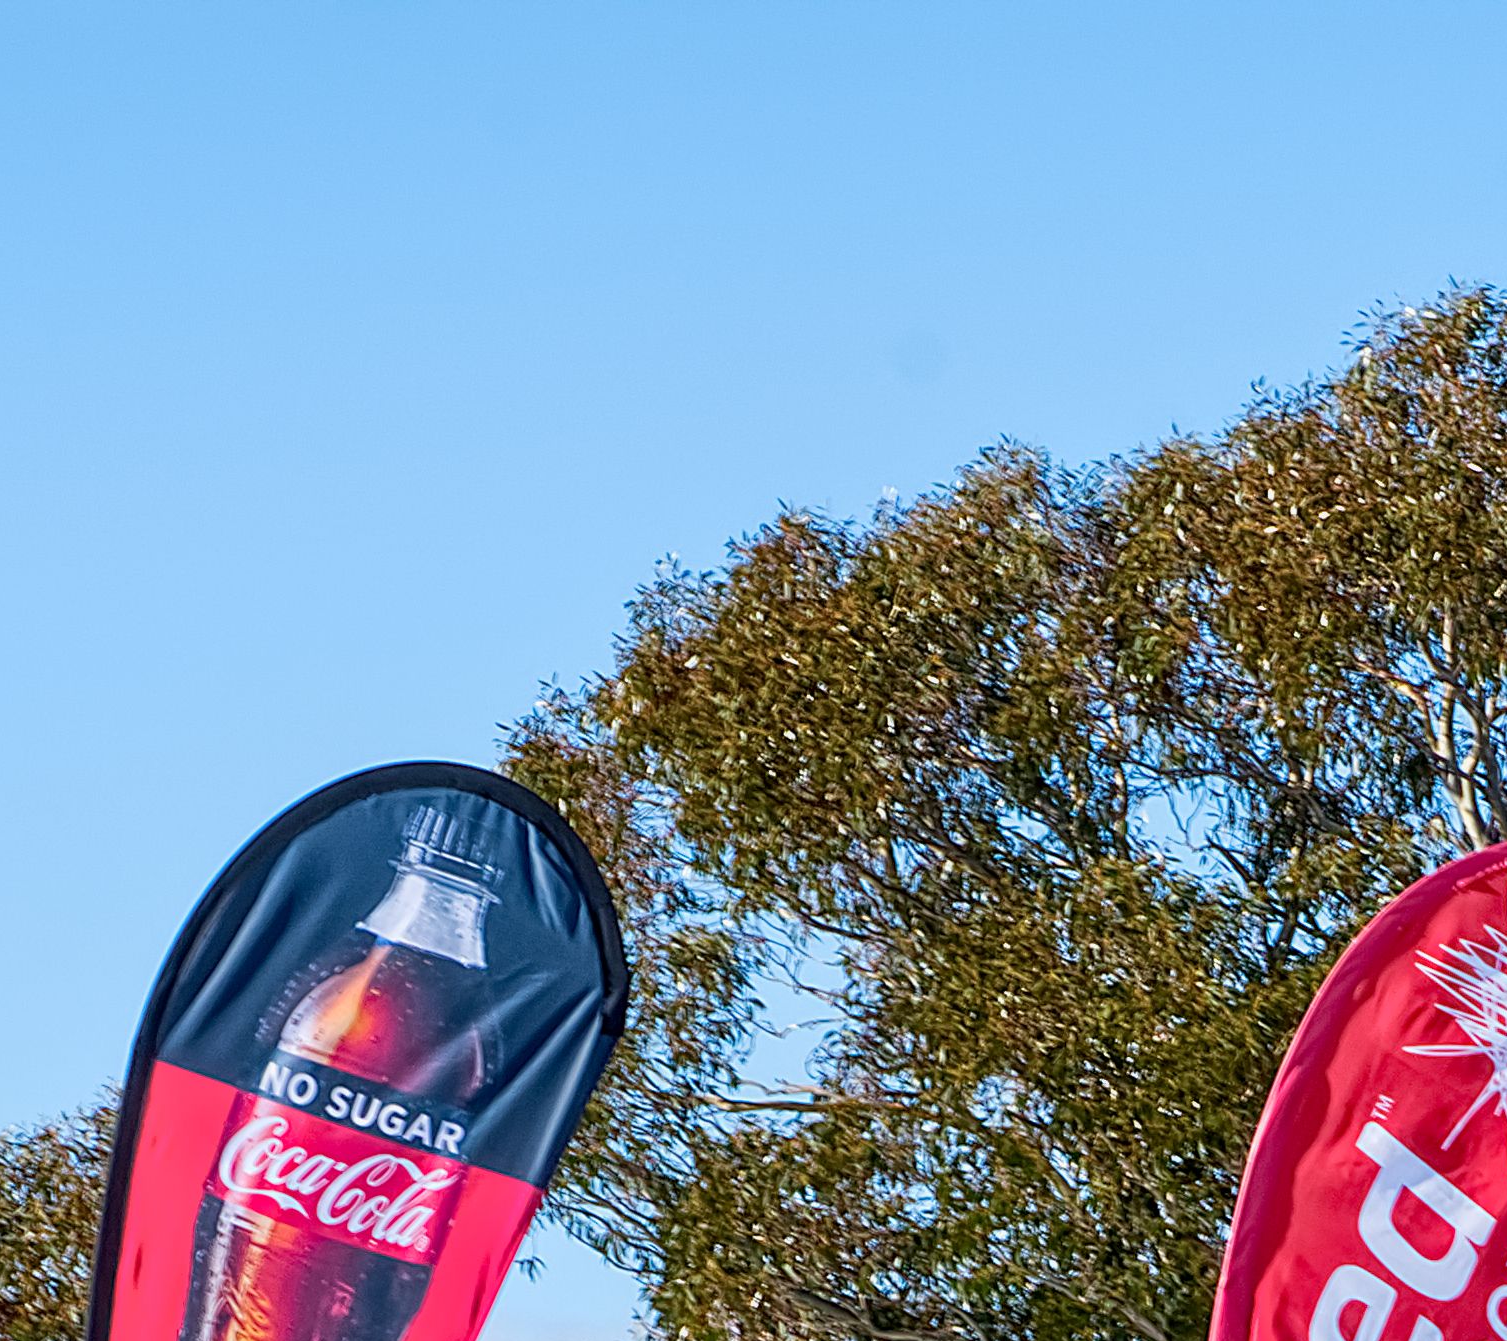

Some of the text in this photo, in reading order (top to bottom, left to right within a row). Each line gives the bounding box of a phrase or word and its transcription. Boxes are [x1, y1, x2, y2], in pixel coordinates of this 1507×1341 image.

[259, 1061, 466, 1155] NO SUGAR
[218, 1115, 461, 1247] Coca-Cola
